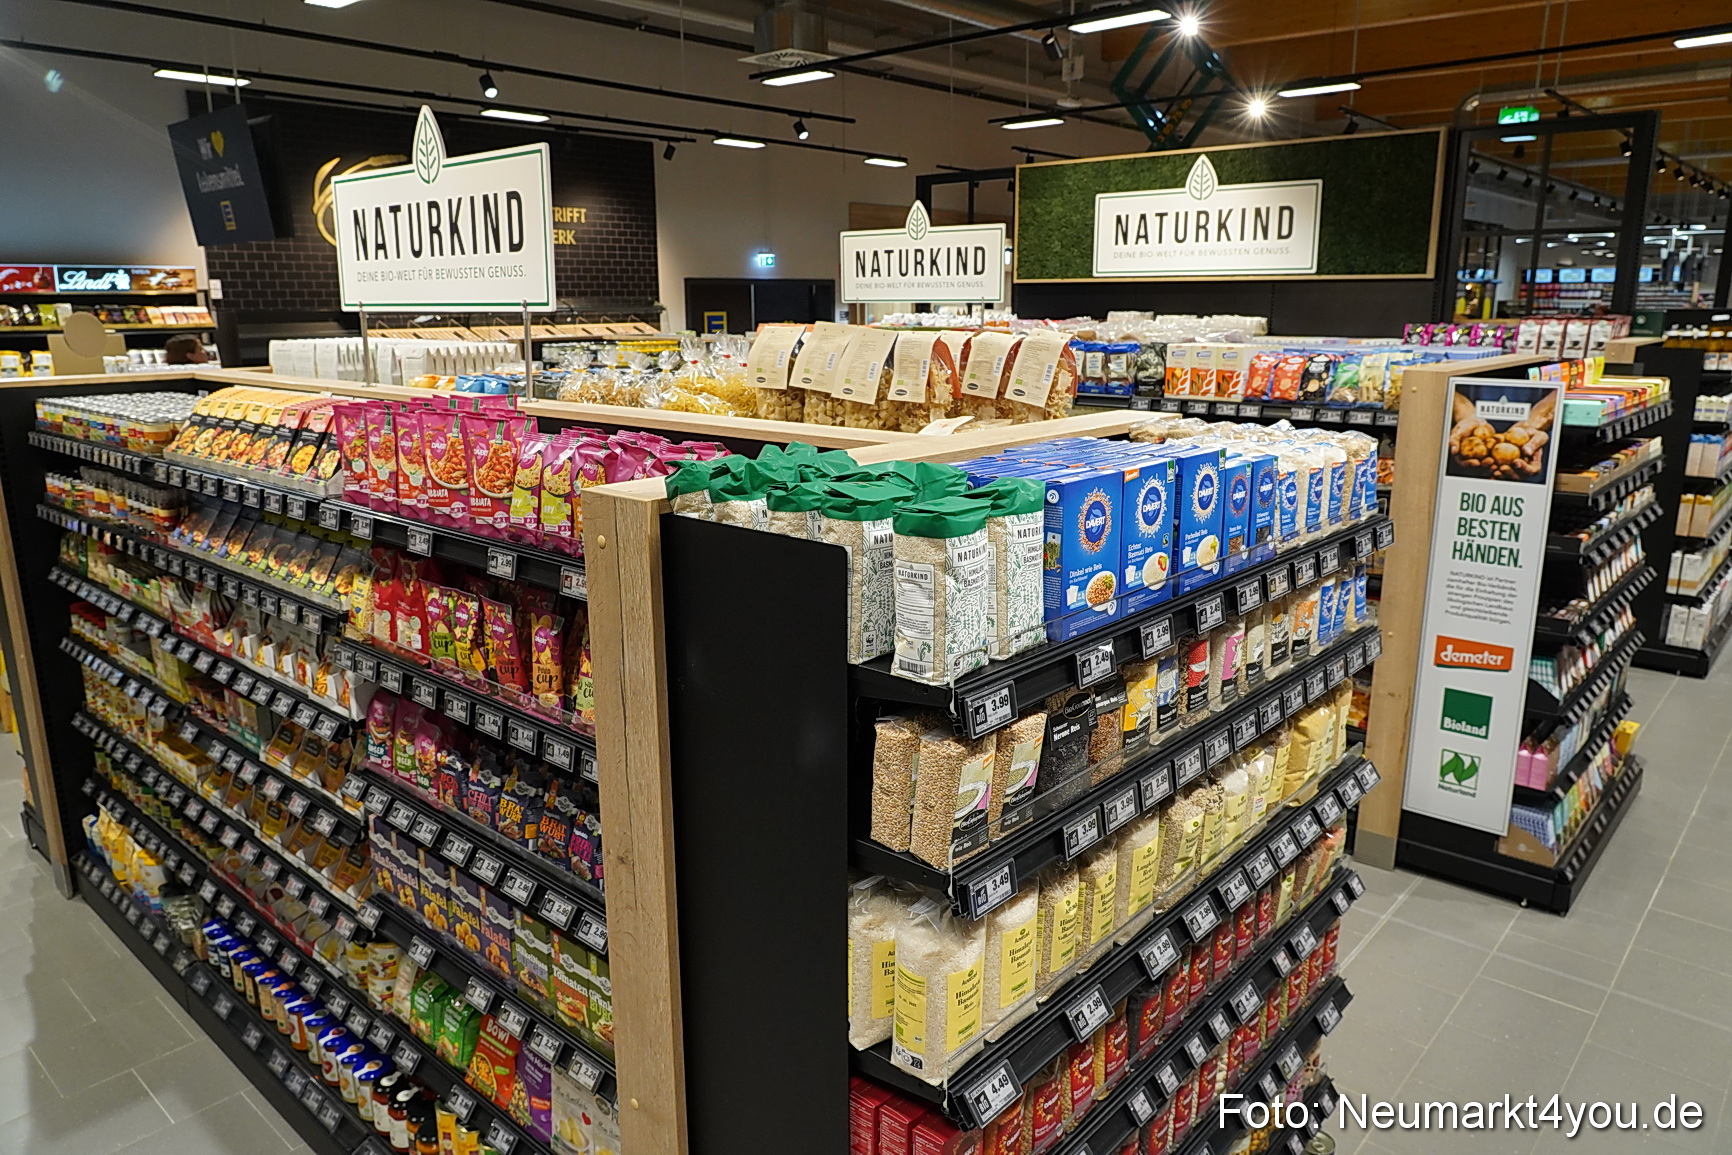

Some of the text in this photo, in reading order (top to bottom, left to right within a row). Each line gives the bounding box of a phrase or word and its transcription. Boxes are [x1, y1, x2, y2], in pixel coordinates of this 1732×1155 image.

[353, 190, 524, 261] NATURKIND
[1114, 205, 1294, 246] NATURKIND
[1113, 251, 1137, 259] DEINE
[1139, 250, 1177, 258] BIO-WELT
[1199, 248, 1250, 256] BEWUSSTEN
[855, 246, 986, 278] NATURKIND
[60, 270, 116, 290] Lindt
[357, 264, 527, 282] DEINE BIO-WELT FÜR BEWUSSTEN GENUSS.
[1480, 405, 1525, 415] NATURKIND
[1198, 487, 1214, 498] DAVERT
[1143, 501, 1161, 513] DAVERT
[1459, 492, 1525, 517] BIO AUS
[1086, 516, 1105, 528] DAVERT
[1456, 517, 1521, 543] BESTEN
[1451, 539, 1523, 568] HÄNDEN.
[501, 558, 512, 568] 2.99
[1069, 563, 1103, 579] Dinkel wie Reis
[1209, 602, 1220, 615] 2.49
[1156, 625, 1169, 639] 2.99
[1095, 651, 1109, 666] 2.49
[1440, 645, 1504, 666] demeter
[991, 694, 1009, 712] 3.99
[488, 715, 499, 726] 1.49
[1443, 717, 1487, 737] Bioland
[1053, 723, 1081, 742] Nerone Reis
[1218, 736, 1228, 749] 3.79
[557, 747, 570, 759] 1.49
[1188, 754, 1199, 767] 3.79
[1155, 775, 1168, 789] 2.99
[467, 790, 492, 806] CHILI
[1437, 783, 1477, 799] Naturland
[1120, 795, 1133, 810] 3.99
[541, 816, 567, 834] BRAT
[1082, 819, 1096, 835] 3.99
[485, 861, 497, 874] 2.99
[517, 880, 530, 893] 2.99
[992, 872, 1009, 891] 3.49
[1234, 877, 1245, 890] 4.49
[420, 881, 447, 910] Falafel
[452, 901, 480, 930] Falafel
[556, 904, 569, 917] 2.99
[1199, 905, 1212, 919] 2.99
[480, 921, 511, 952] Falafel
[593, 926, 607, 941] 2.99
[1157, 940, 1171, 955] 2.99
[552, 964, 588, 997] Tomaten
[1087, 998, 1102, 1014] 2.99
[1079, 1057, 1093, 1070] DAVERT
[584, 1068, 596, 1081] 2.29
[991, 1074, 1009, 1095] 4.49
[1043, 1094, 1059, 1110] DAVERT
